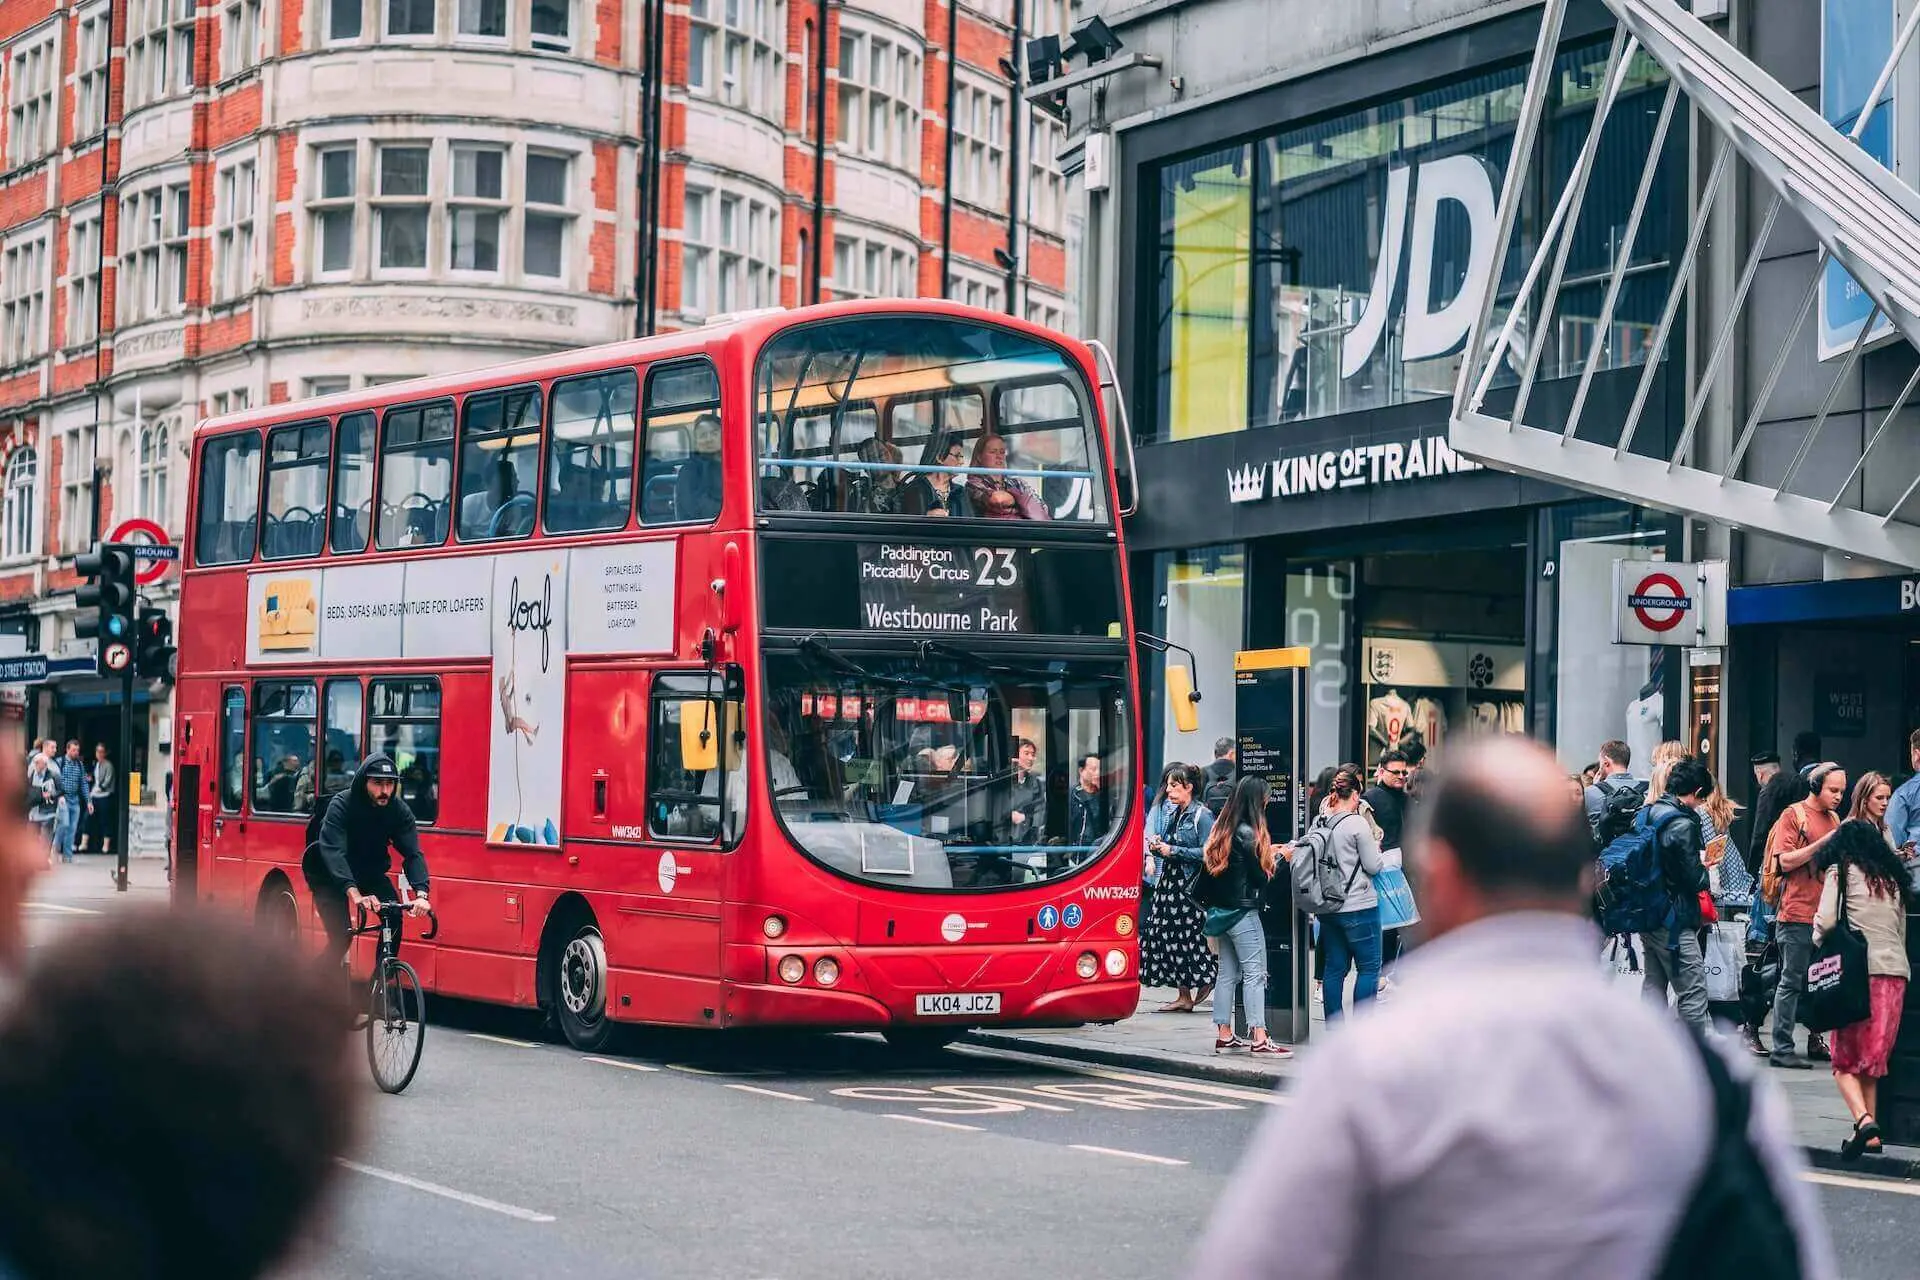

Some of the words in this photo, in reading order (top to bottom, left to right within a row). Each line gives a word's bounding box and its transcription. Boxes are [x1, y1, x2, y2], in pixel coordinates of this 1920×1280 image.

[1341, 154, 1497, 379] JD
[1845, 280, 1863, 299] SHO
[1272, 452, 1337, 497] KING
[1339, 448, 1366, 476] OF
[1366, 436, 1484, 482] TRAIN
[605, 564, 642, 576] SPITALFIELDS
[862, 562, 923, 582] Piccadilly
[929, 564, 970, 580] Circus
[881, 544, 952, 565] Paddington
[974, 547, 1018, 586] 23
[604, 584, 628, 593] NOTTING
[629, 583, 642, 592] HILL
[327, 606, 347, 620] BEDS,
[348, 605, 370, 618] SOFAS
[372, 604, 387, 617] AND
[389, 600, 430, 616] FURNITURE
[432, 600, 448, 614] FOR
[450, 598, 484, 613] LOAFERS
[607, 600, 638, 611] BATTERSEA
[1631, 597, 1689, 609] UNDERGROUND
[507, 573, 552, 674] loaf
[866, 603, 971, 631] Westbourne
[980, 607, 1018, 631] Park
[4, 662, 23, 678] STREET
[23, 658, 47, 676] STATION
[1838, 705, 1863, 719] one
[611, 825, 642, 838] VNW32423
[1083, 886, 1140, 901] VNW32423
[922, 995, 961, 1013] LK04
[965, 994, 994, 1012] JCZ
